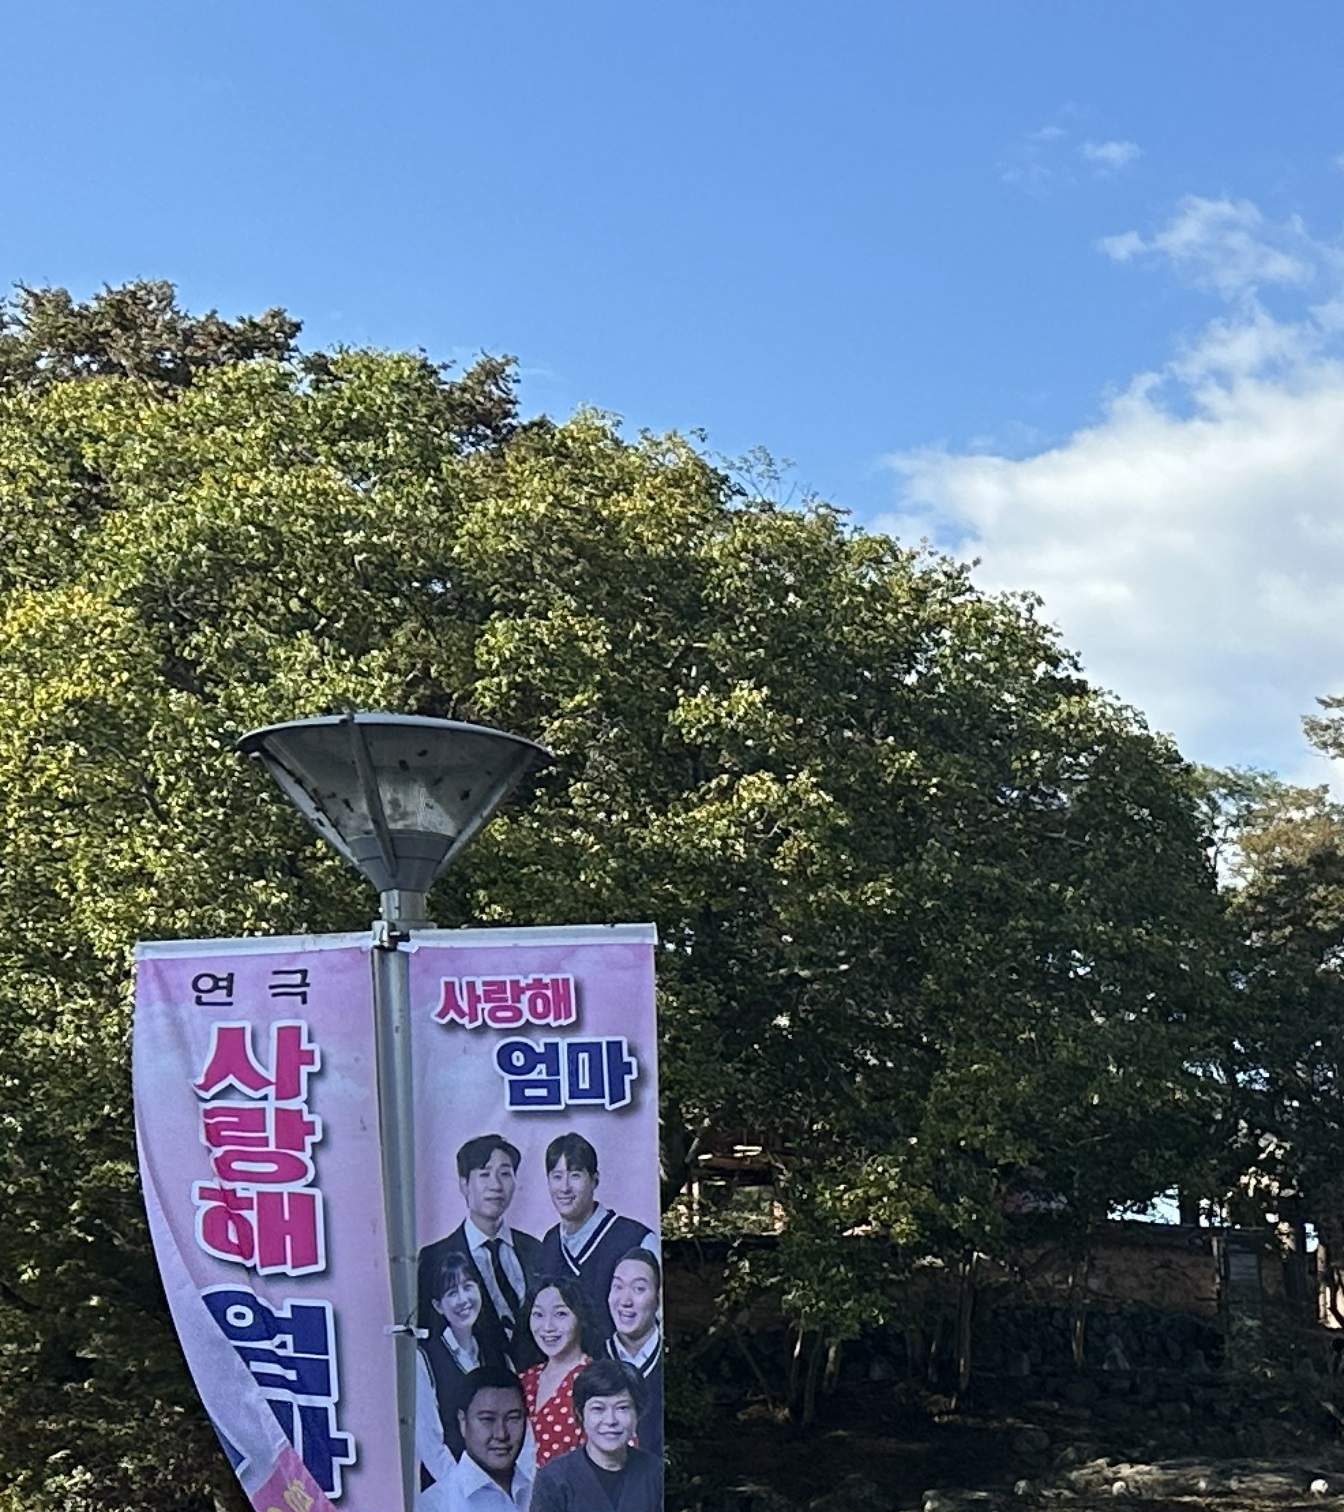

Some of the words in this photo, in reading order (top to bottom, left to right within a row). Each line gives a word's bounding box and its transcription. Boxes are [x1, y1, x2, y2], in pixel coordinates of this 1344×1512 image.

[432, 975, 577, 1028] 사랑해
[494, 1036, 638, 1110] 엄마
[191, 1020, 326, 1276] 사랑해
